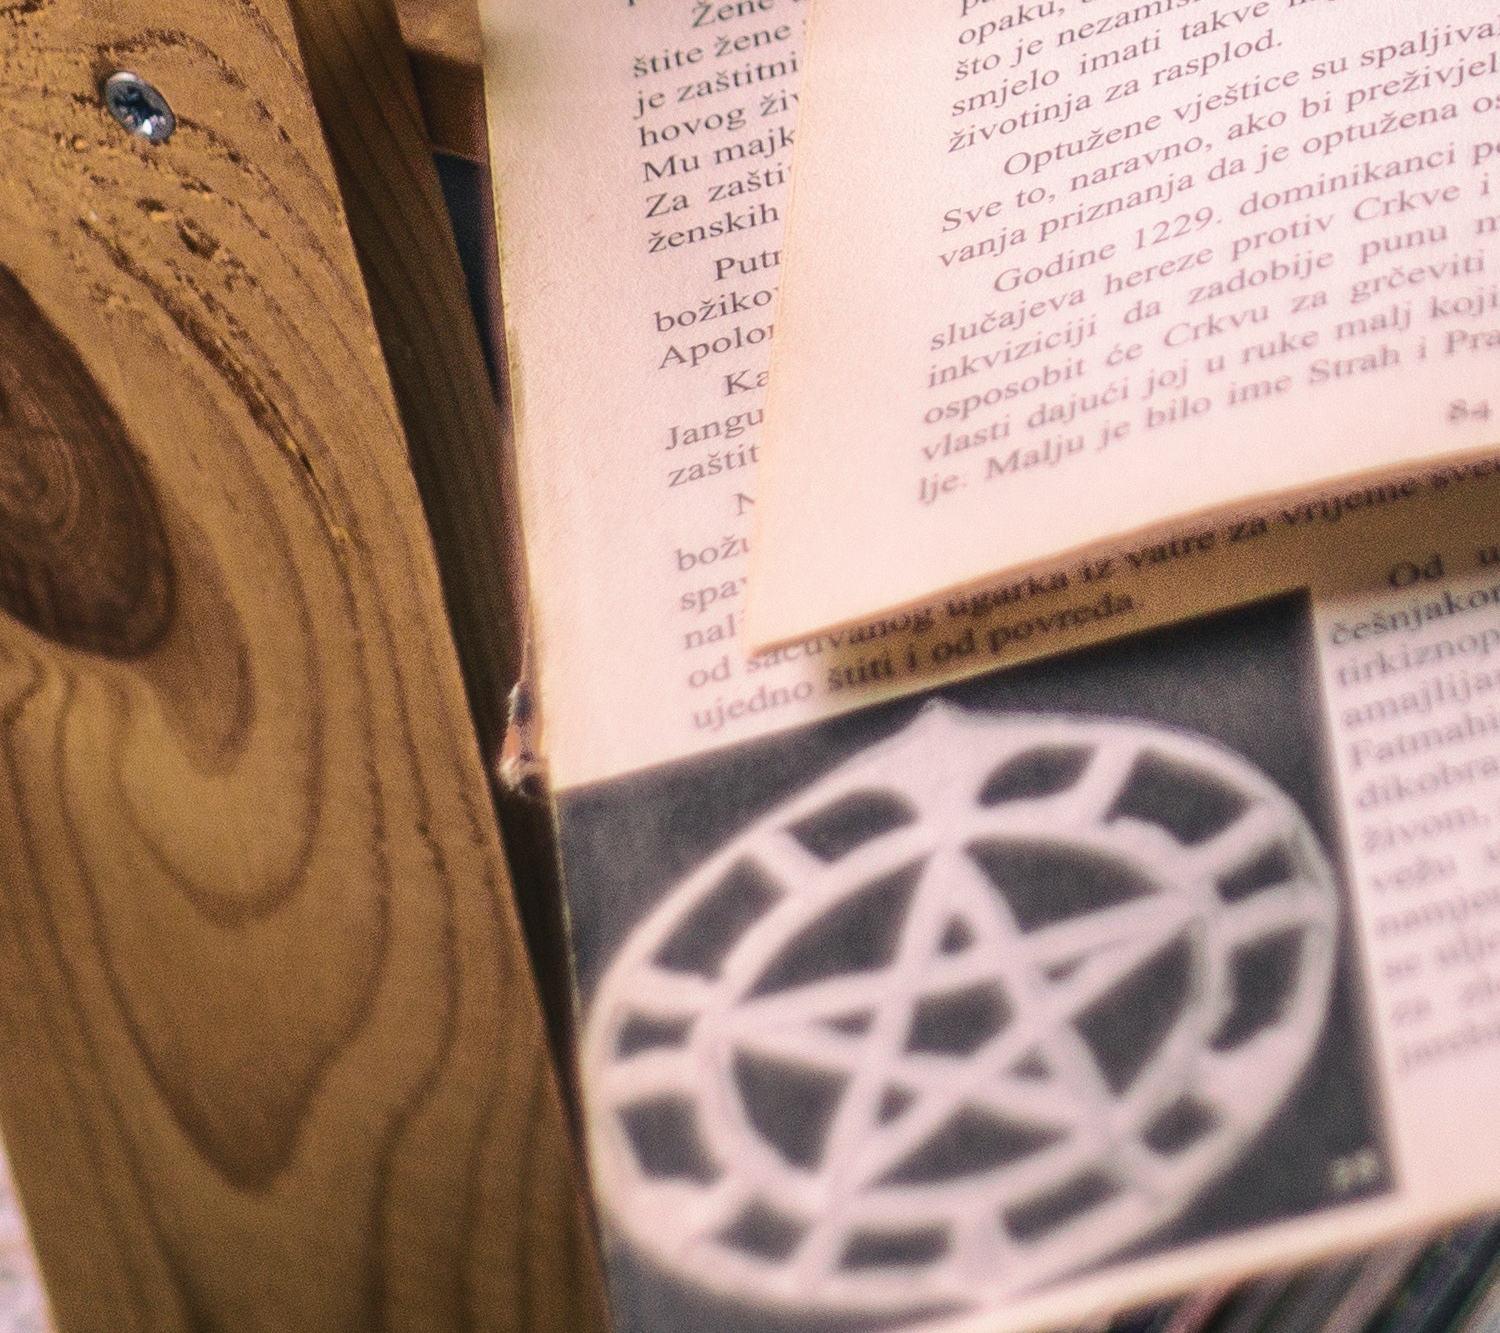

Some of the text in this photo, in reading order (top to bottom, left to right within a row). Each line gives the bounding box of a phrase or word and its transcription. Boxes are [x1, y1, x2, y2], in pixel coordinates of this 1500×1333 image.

[691, 0, 775, 28] Žene
[633, 24, 791, 78] štite žene
[947, 31, 1284, 157] životinja rasplod.
[638, 108, 748, 148] hovog
[1003, 106, 1162, 181] Optužene
[1174, 66, 1299, 127] vještice
[643, 155, 700, 183] Mu
[1039, 169, 1193, 241] priznanja
[1303, 99, 1458, 156] optužena
[1070, 135, 1212, 194] naravno,
[646, 193, 689, 218] Za
[648, 203, 779, 253] ženskih
[993, 243, 1116, 293] Godine
[1134, 205, 1222, 252] 1229.
[1239, 142, 1456, 217] dominikanci
[1232, 209, 1335, 261] protiv
[1353, 182, 1461, 222] Crkve
[1308, 343, 1401, 389] Strah
